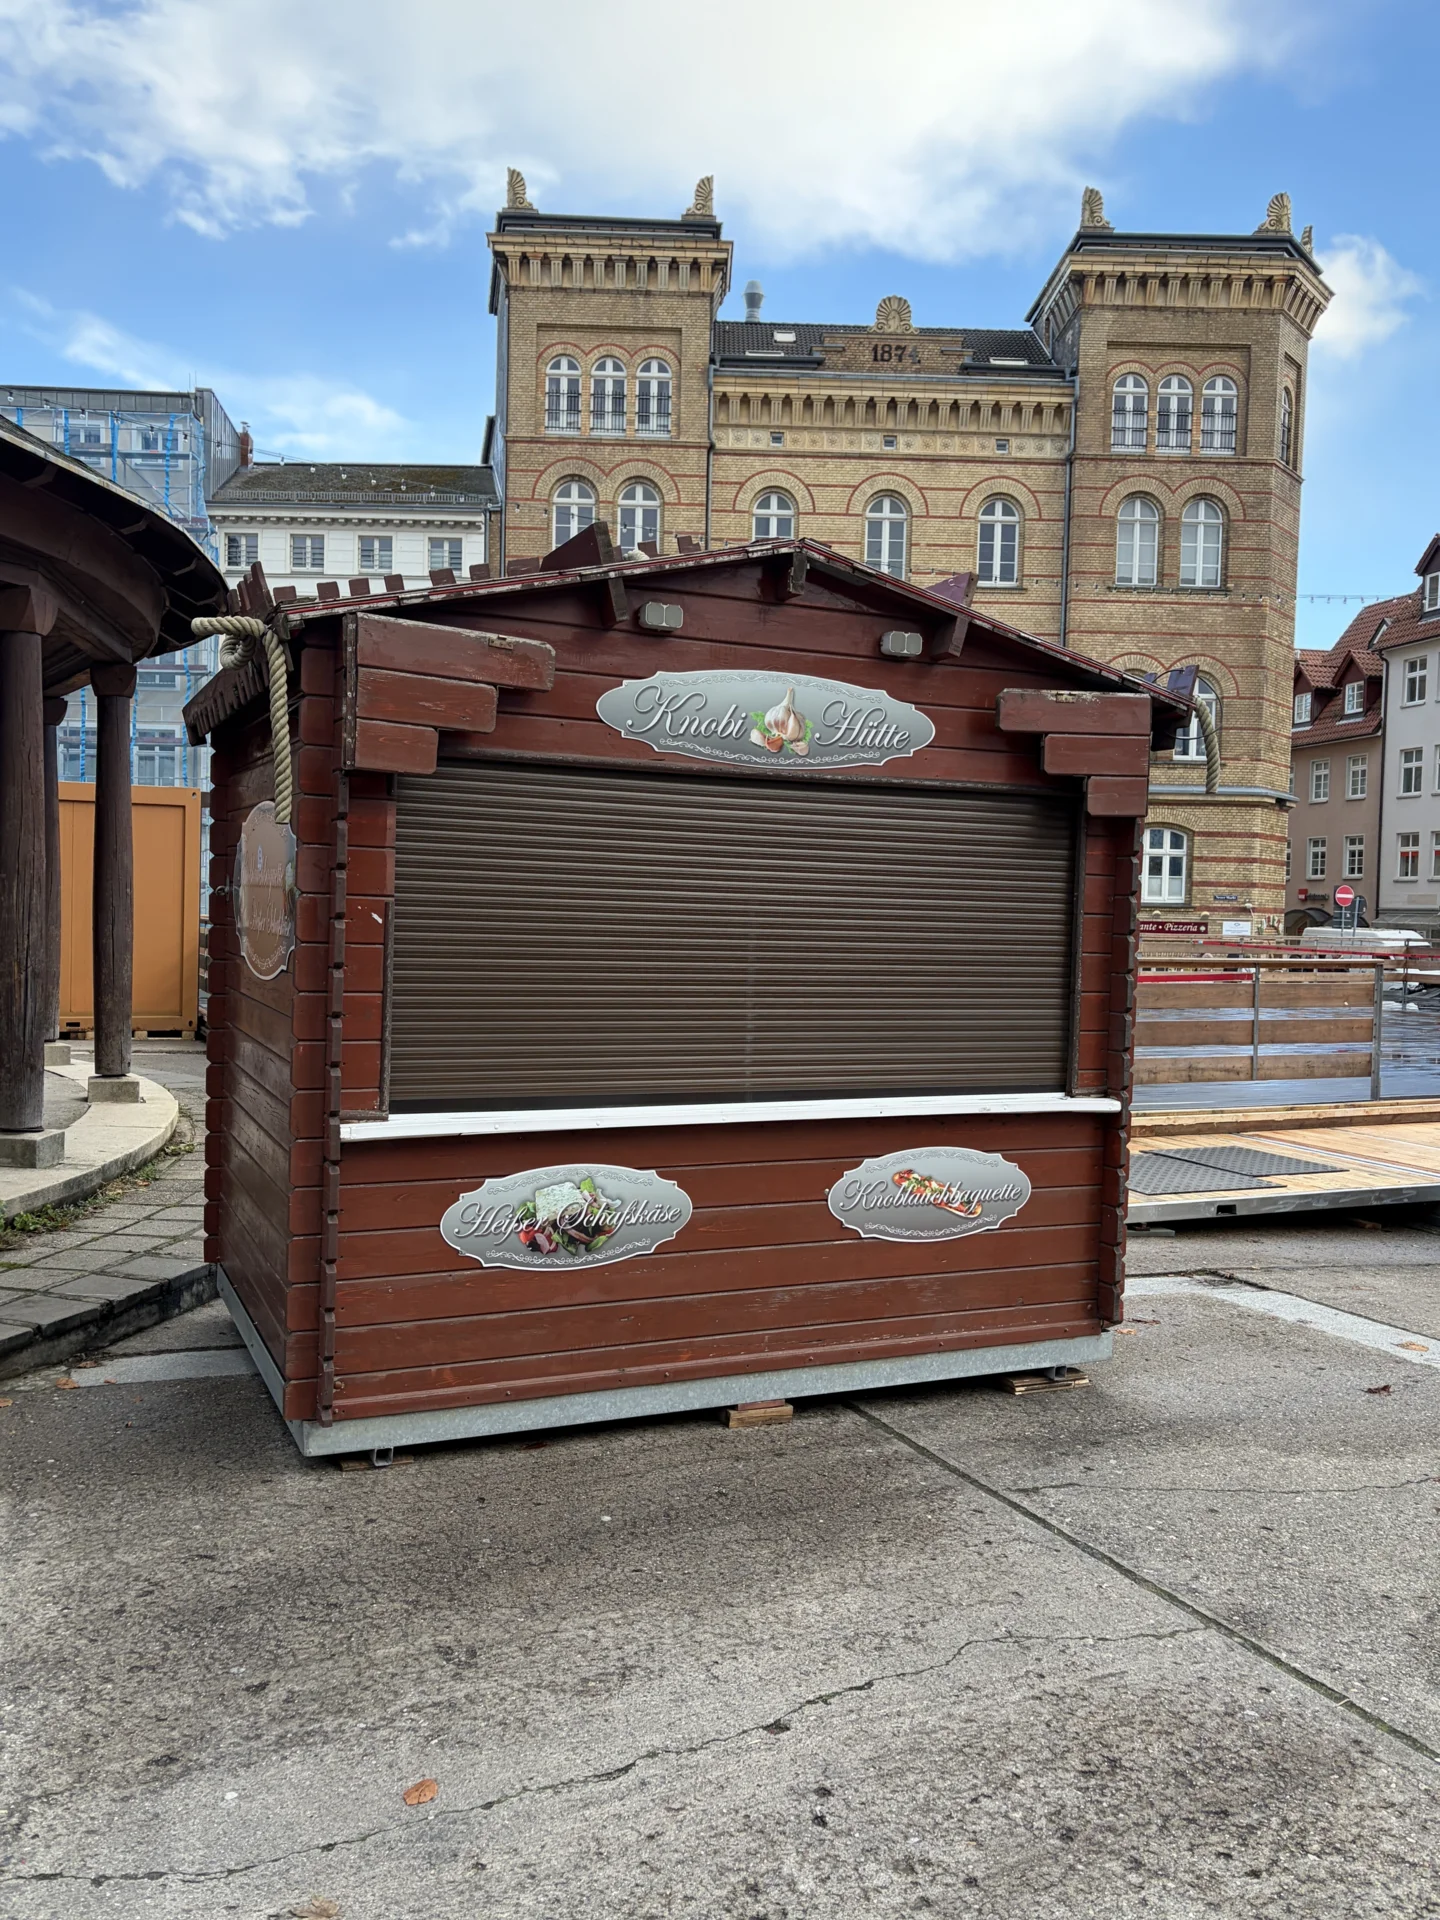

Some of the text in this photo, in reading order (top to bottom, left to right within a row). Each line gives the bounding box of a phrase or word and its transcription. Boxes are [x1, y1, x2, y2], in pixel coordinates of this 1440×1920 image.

[626, 684, 911, 750] Knobi Hütte
[1163, 921, 1198, 933] Pizzeria
[839, 1178, 1022, 1213] Knoblauchbaguette
[454, 1199, 682, 1245] Heißer Schafskäse
